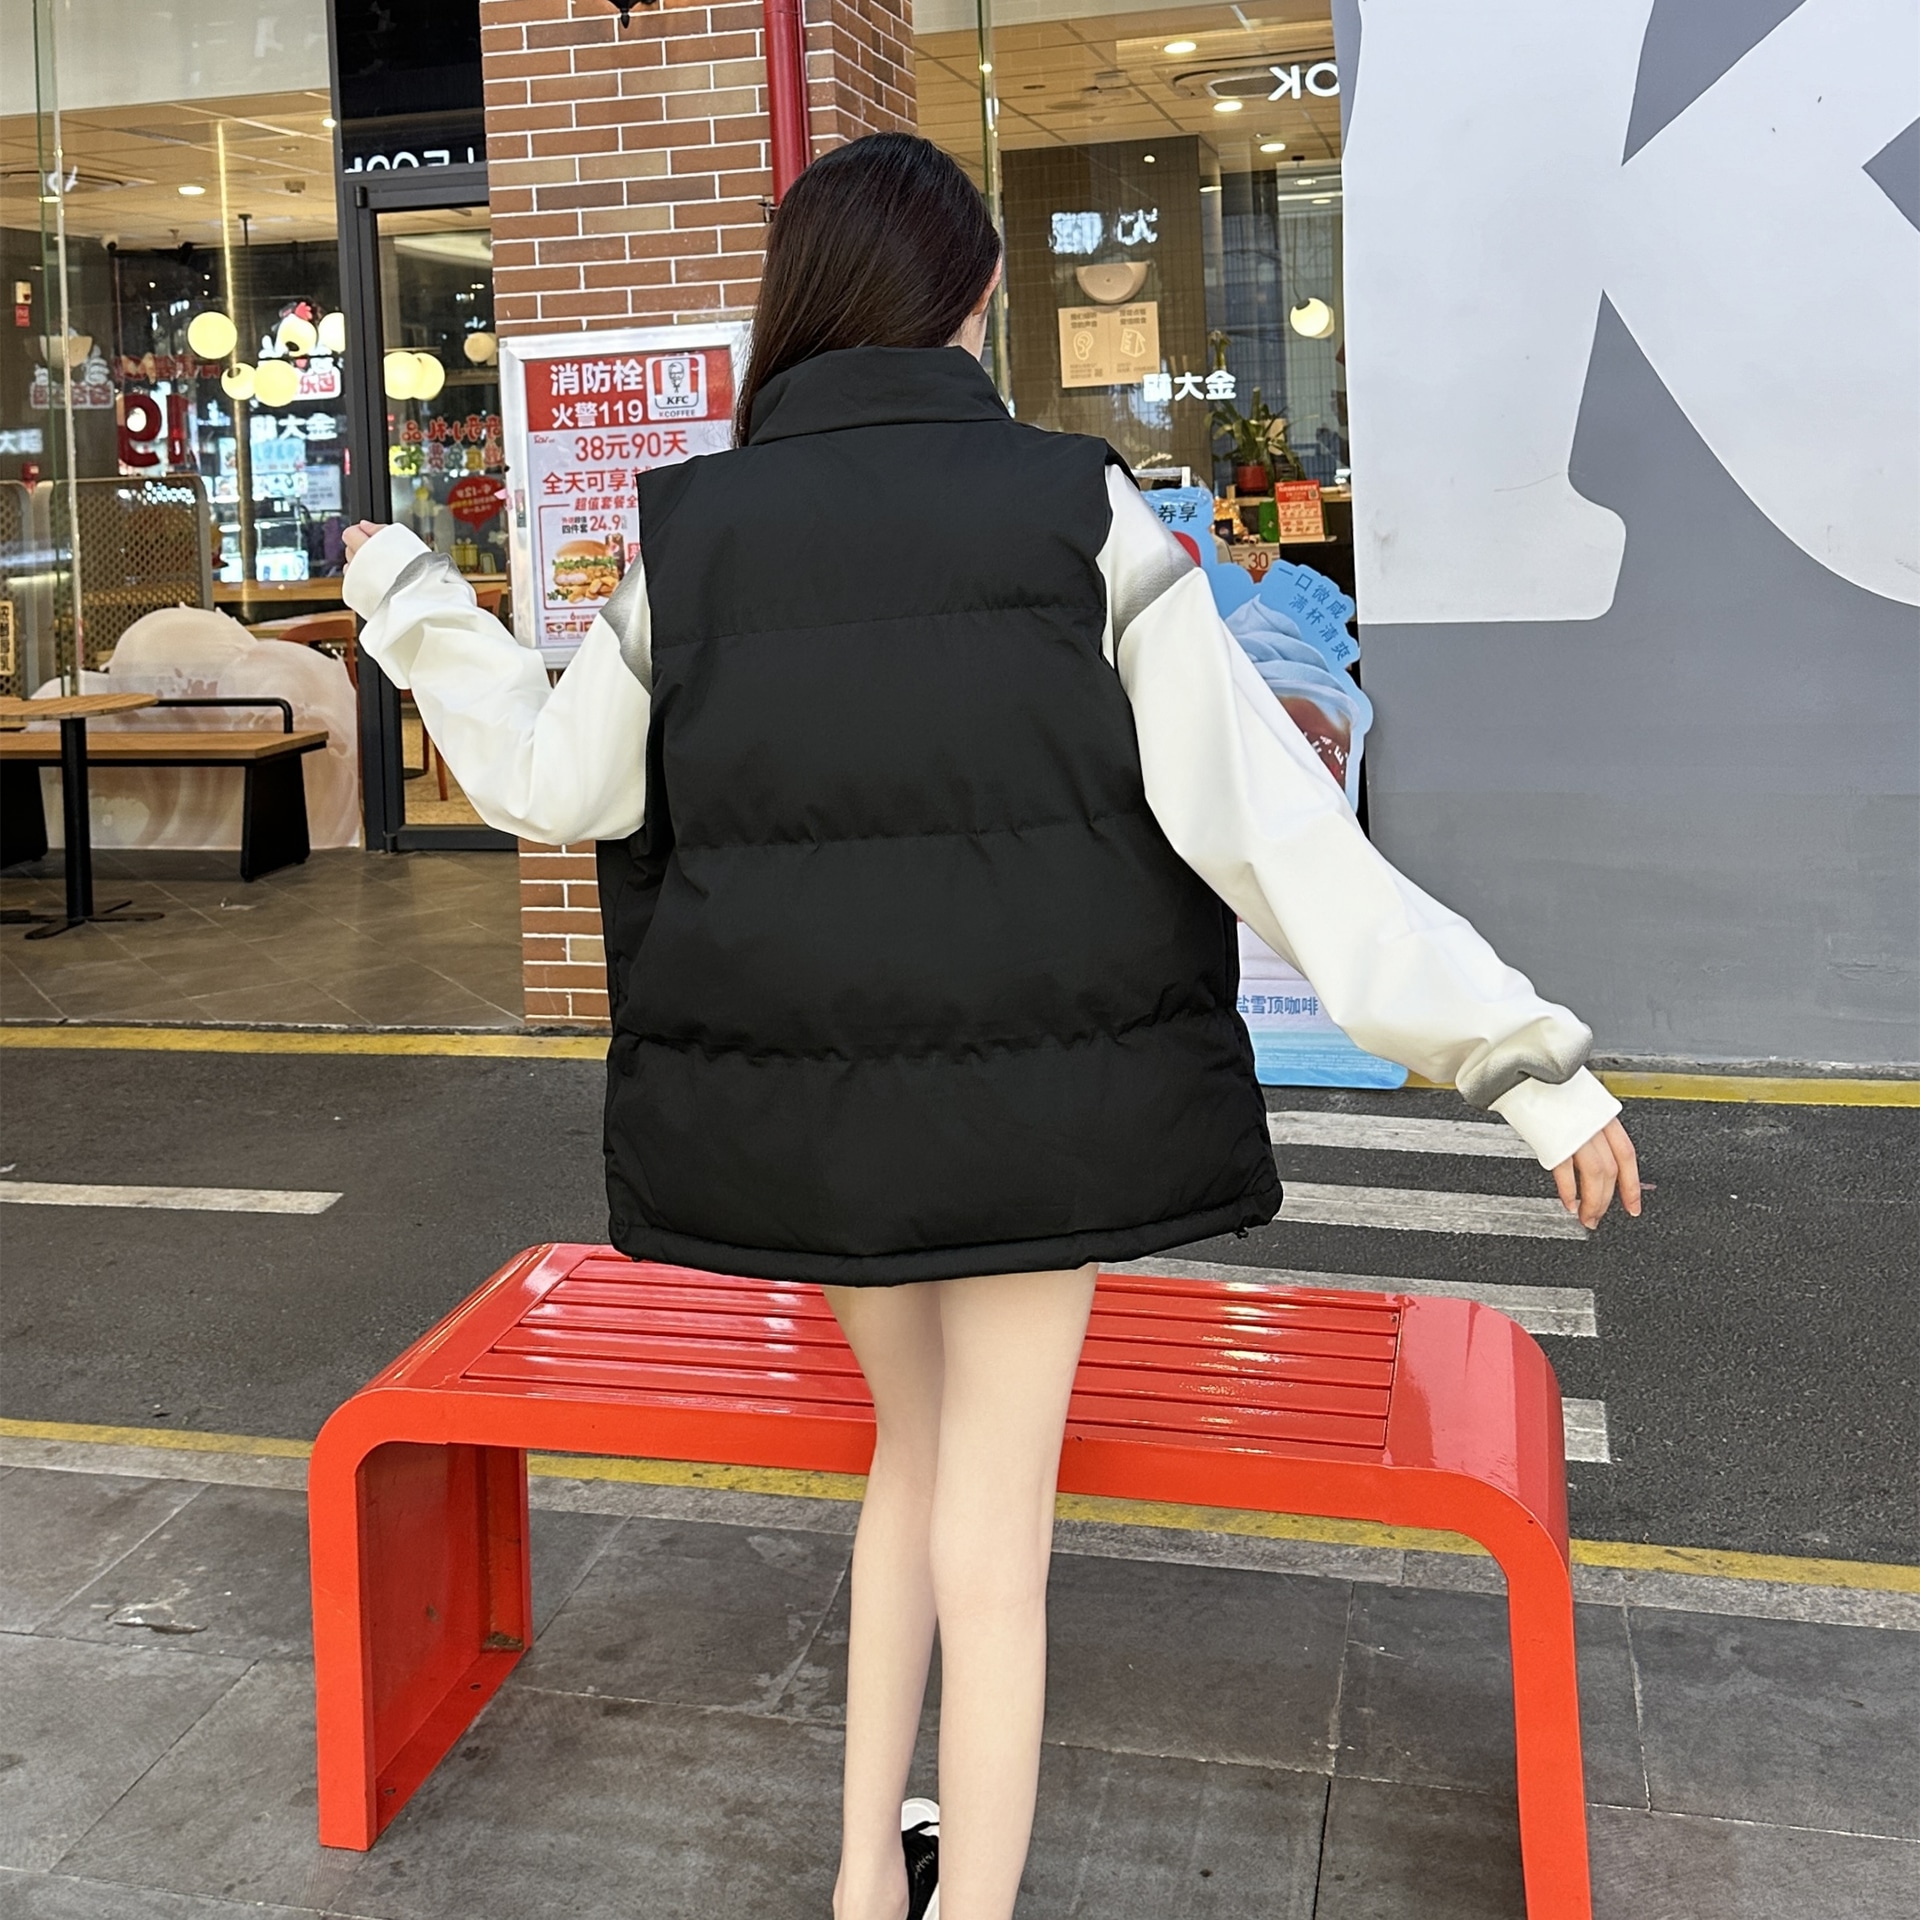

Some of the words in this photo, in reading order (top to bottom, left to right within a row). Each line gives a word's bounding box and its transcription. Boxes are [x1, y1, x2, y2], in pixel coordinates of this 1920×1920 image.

[550, 359, 644, 396] 消防栓
[551, 398, 644, 429] 火警119
[666, 395, 689, 406] KFC
[574, 430, 689, 462] 38元90天
[1150, 501, 1198, 524] 券享
[1278, 567, 1347, 620] 一口微咸
[1288, 593, 1351, 661] 满杯清爽
